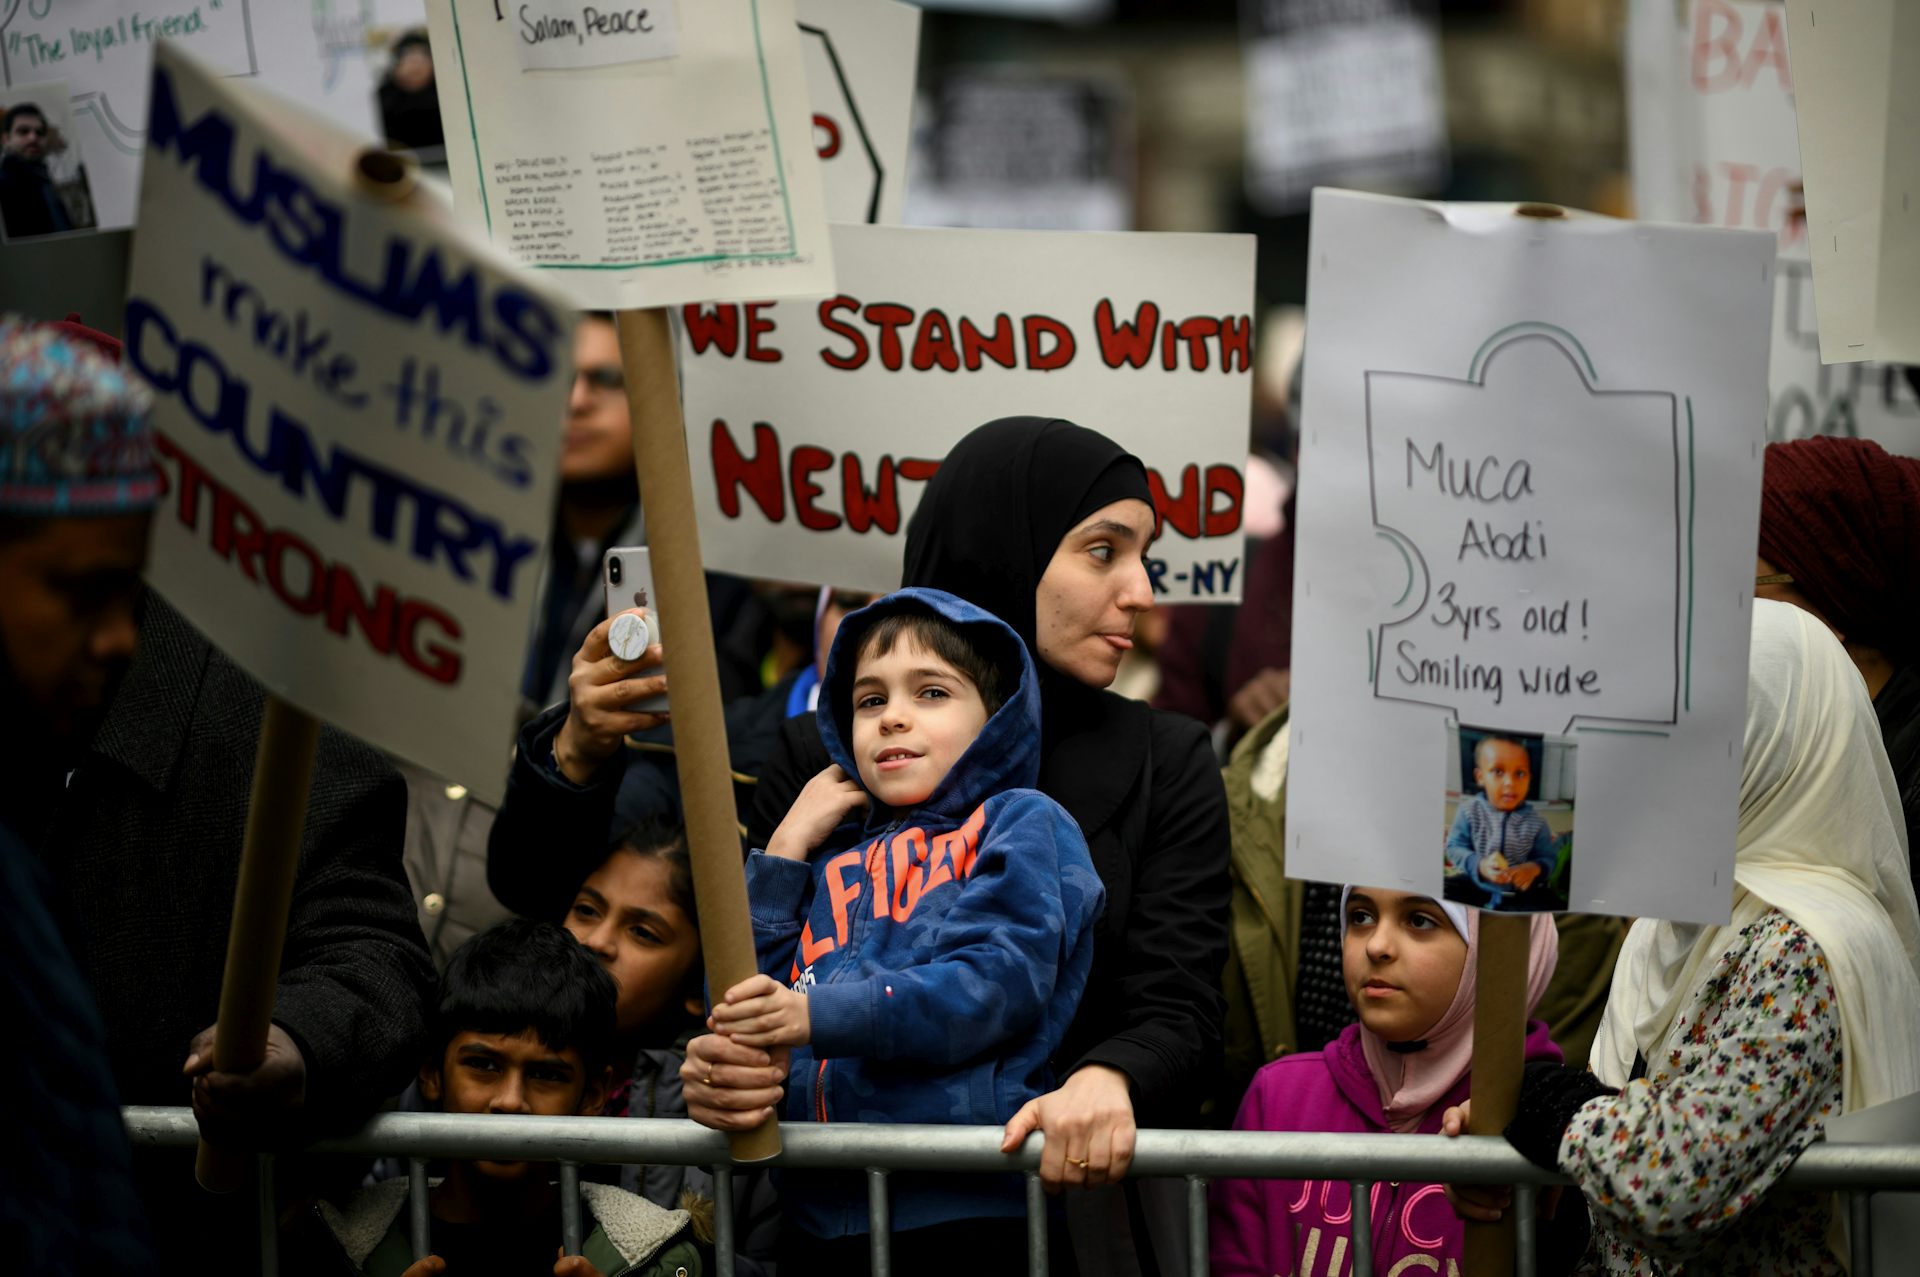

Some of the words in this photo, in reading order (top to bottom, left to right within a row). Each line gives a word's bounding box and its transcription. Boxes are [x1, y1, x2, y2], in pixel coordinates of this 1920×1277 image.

[148, 62, 567, 383] MUSLIMS
[683, 300, 785, 363] WE
[818, 294, 1077, 373] STAND
[1092, 298, 1252, 374] WITH
[202, 255, 371, 410] make
[383, 354, 535, 490] this
[123, 296, 538, 603] COUNTRY
[1405, 437, 1535, 503] Muca
[1457, 518, 1548, 562] Abdi
[1431, 581, 1502, 642] 3yrs
[1396, 639, 1503, 706] Smiling
